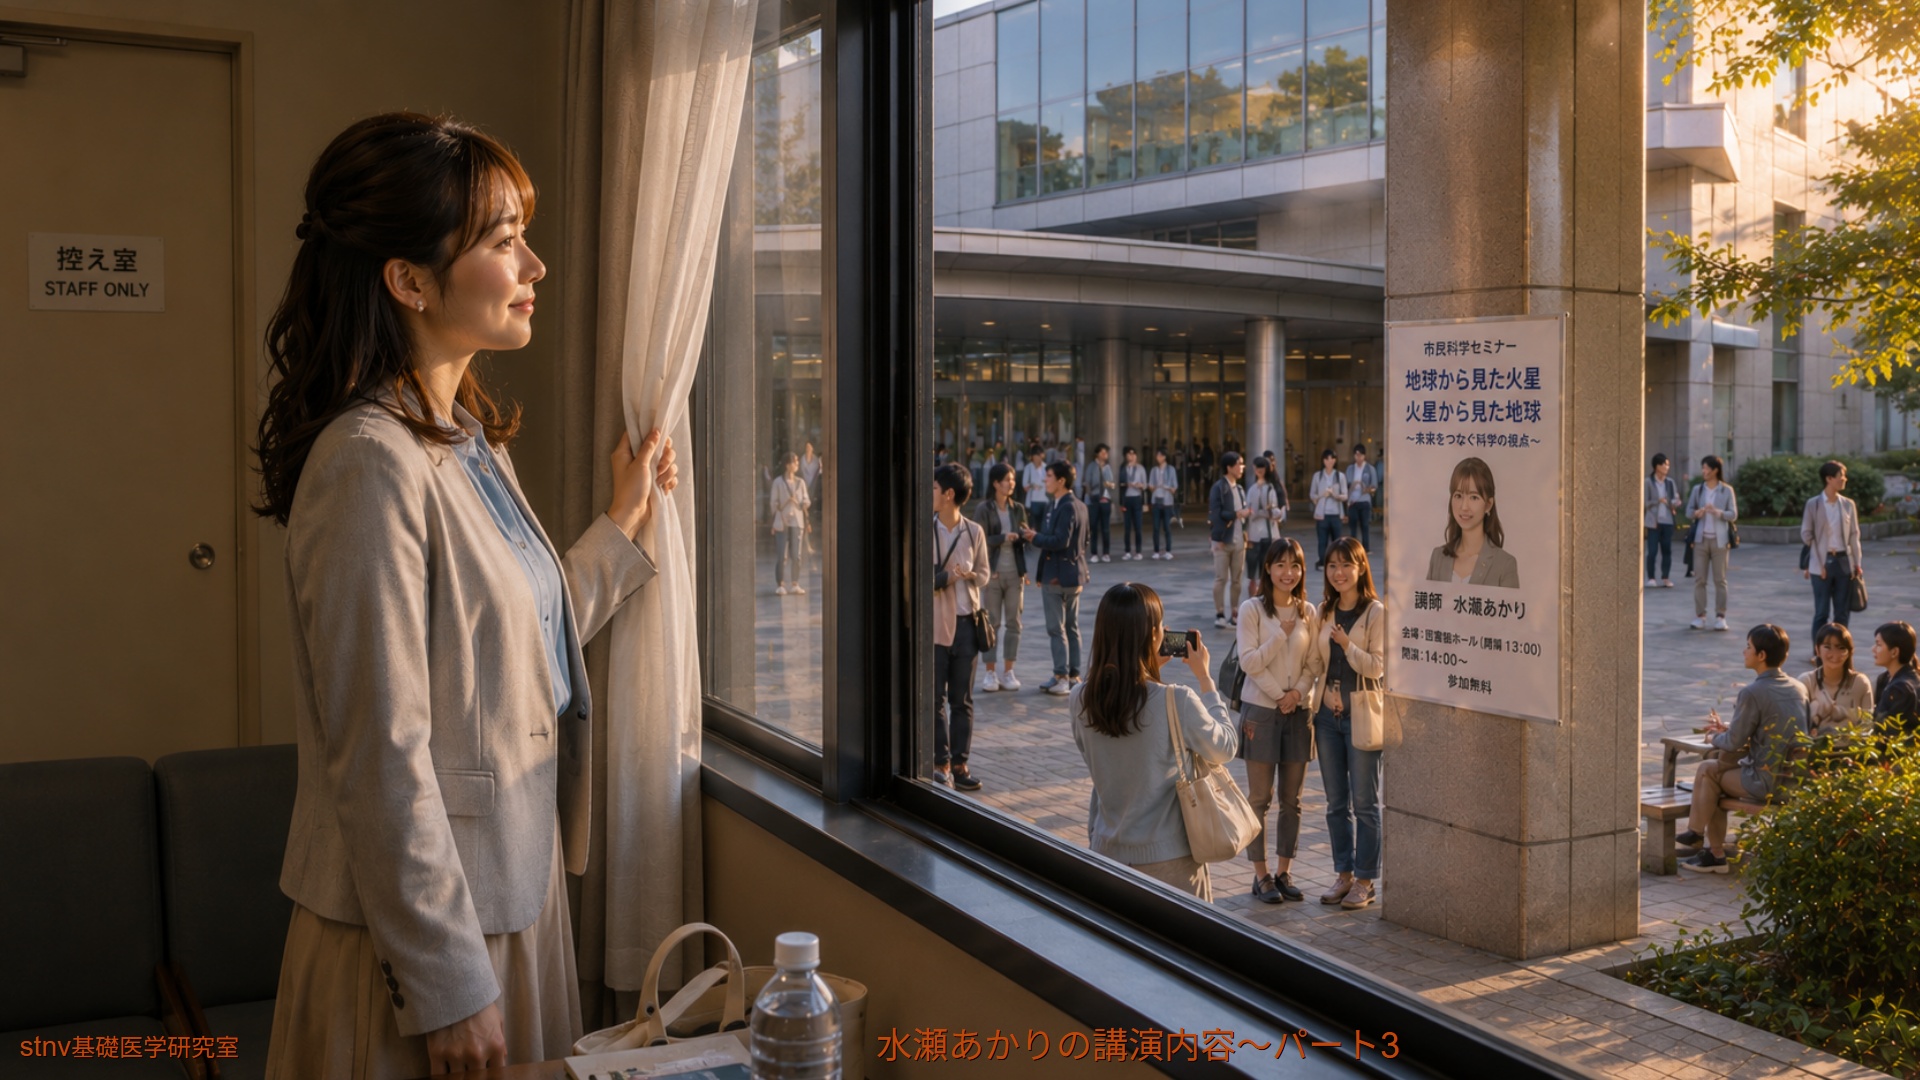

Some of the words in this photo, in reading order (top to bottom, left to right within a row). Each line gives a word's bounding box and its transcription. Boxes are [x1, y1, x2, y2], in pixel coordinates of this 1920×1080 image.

[57, 246, 138, 272] 控え室
[45, 281, 98, 296] STAFF
[104, 282, 149, 297] ONLY
[1424, 339, 1516, 357] 市民科学セミナー
[1405, 367, 1541, 391] 地球から見た火星
[1406, 399, 1542, 423] 火星から見た地球
[1414, 591, 1442, 611] 講師
[1447, 673, 1492, 695] 参加無料
